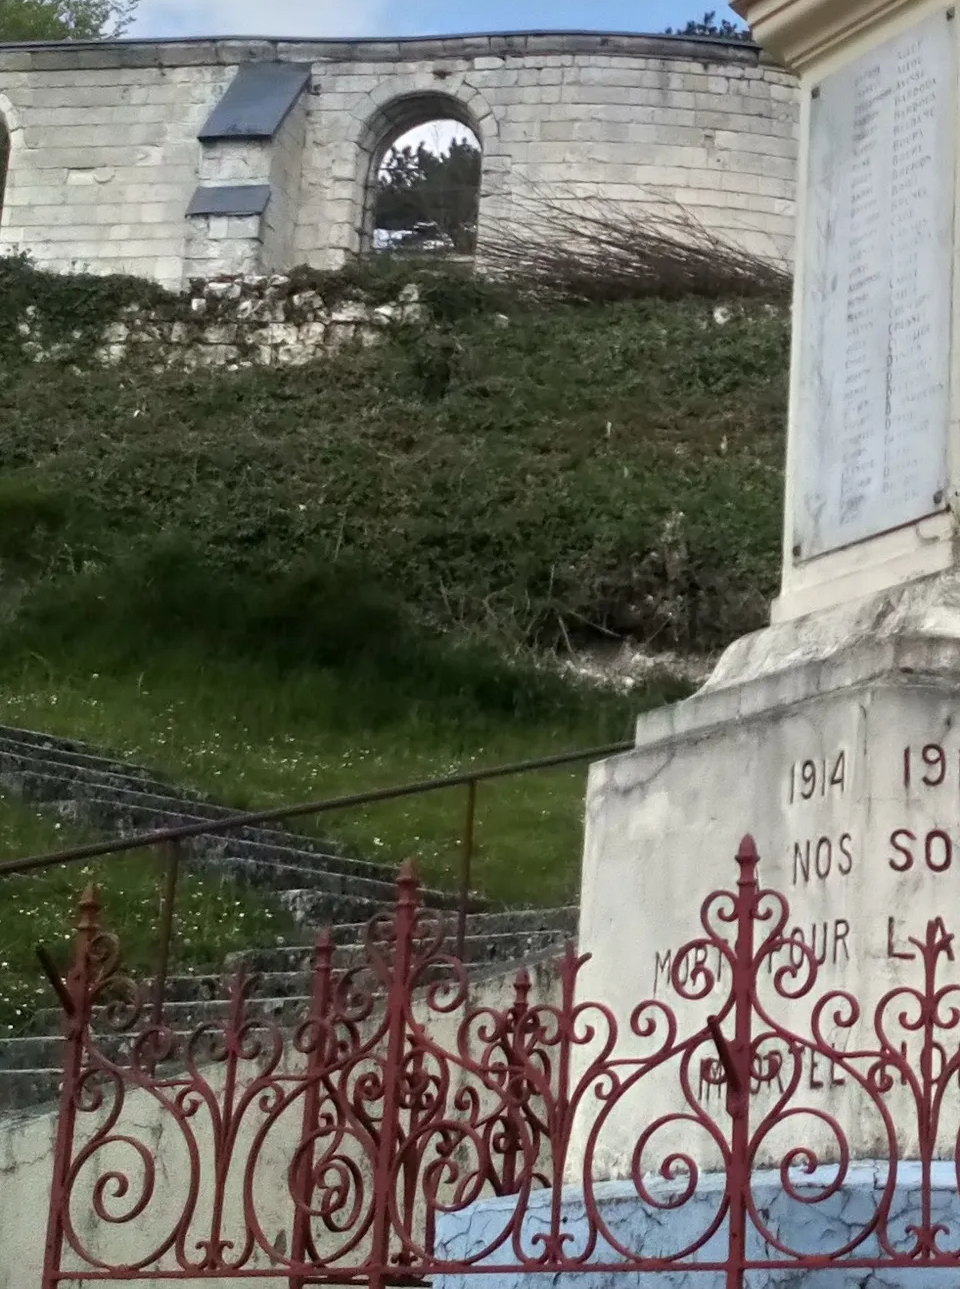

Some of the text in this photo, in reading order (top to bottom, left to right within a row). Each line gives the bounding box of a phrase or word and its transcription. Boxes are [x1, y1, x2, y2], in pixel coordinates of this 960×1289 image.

[789, 750, 846, 804] 1914
[792, 832, 853, 886] NOS
[653, 935, 742, 997] MORT
[767, 918, 850, 975] POUR
[887, 916, 954, 961] LA
[698, 1042, 846, 1101] IMOREL
